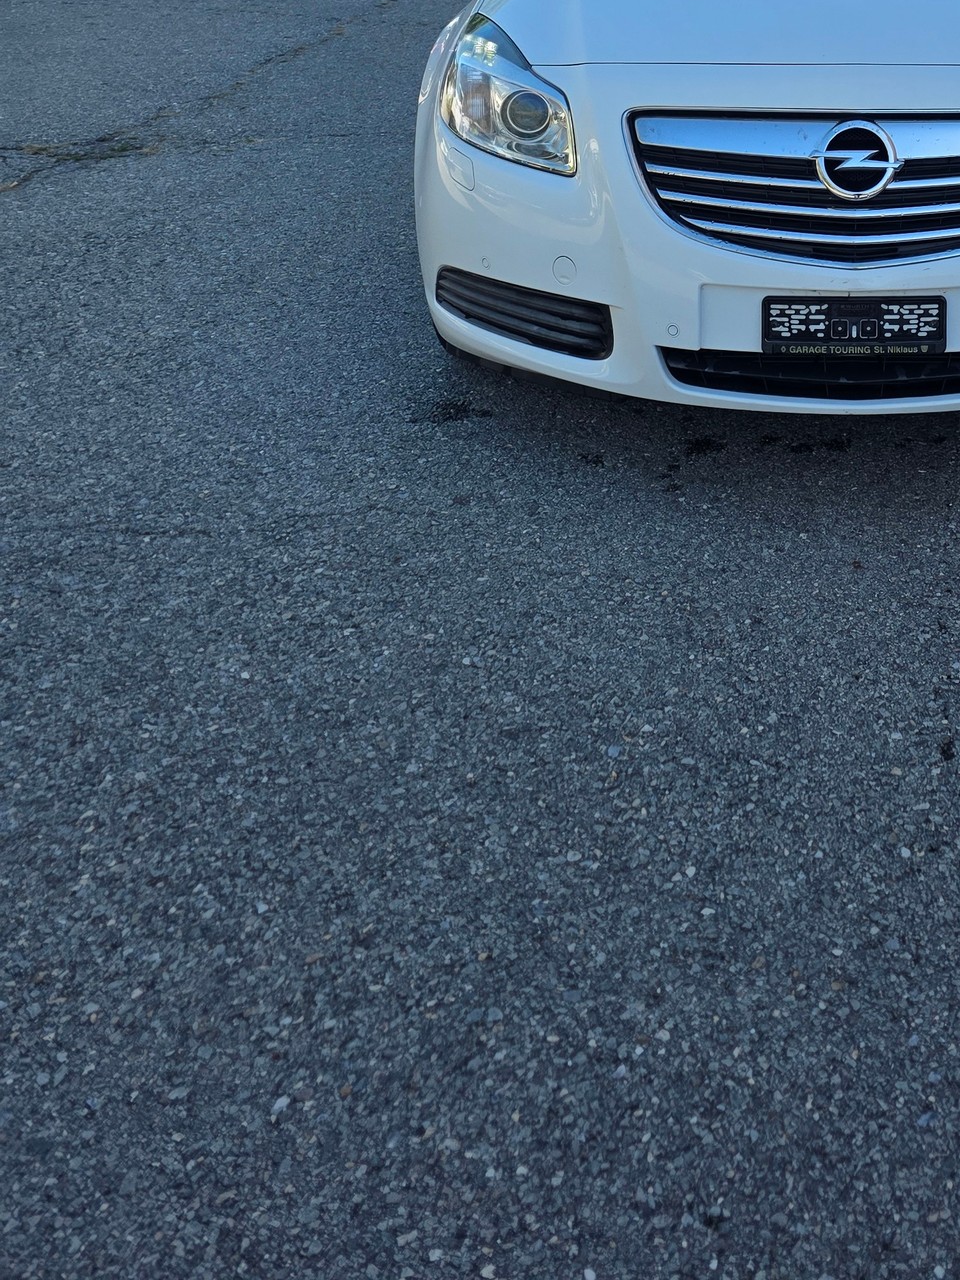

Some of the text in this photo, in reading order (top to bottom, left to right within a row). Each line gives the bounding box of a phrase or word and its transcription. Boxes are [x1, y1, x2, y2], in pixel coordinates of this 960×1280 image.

[789, 345, 918, 354] GARAGE TOURING St. Niklaus
